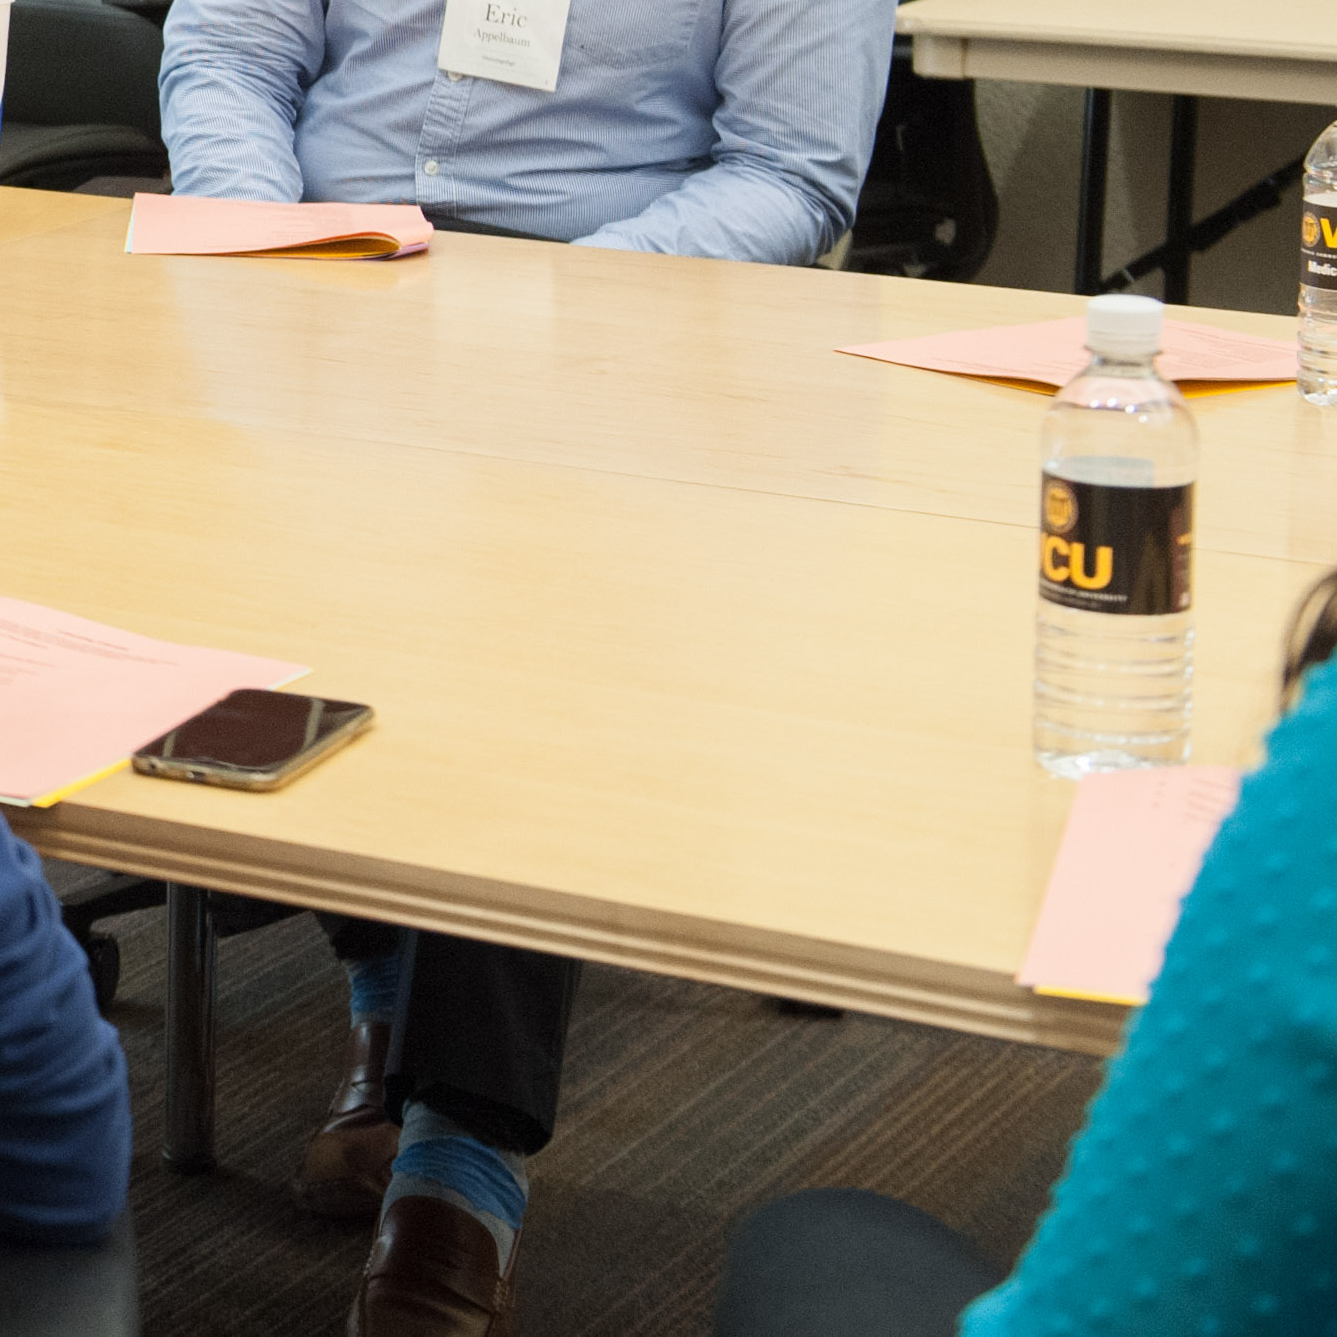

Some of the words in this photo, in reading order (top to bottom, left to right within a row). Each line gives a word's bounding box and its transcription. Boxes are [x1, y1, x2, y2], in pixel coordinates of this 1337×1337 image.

[486, 3, 527, 28] Eric
[474, 28, 531, 47] Appelbaum
[1040, 531, 1113, 590] CU
